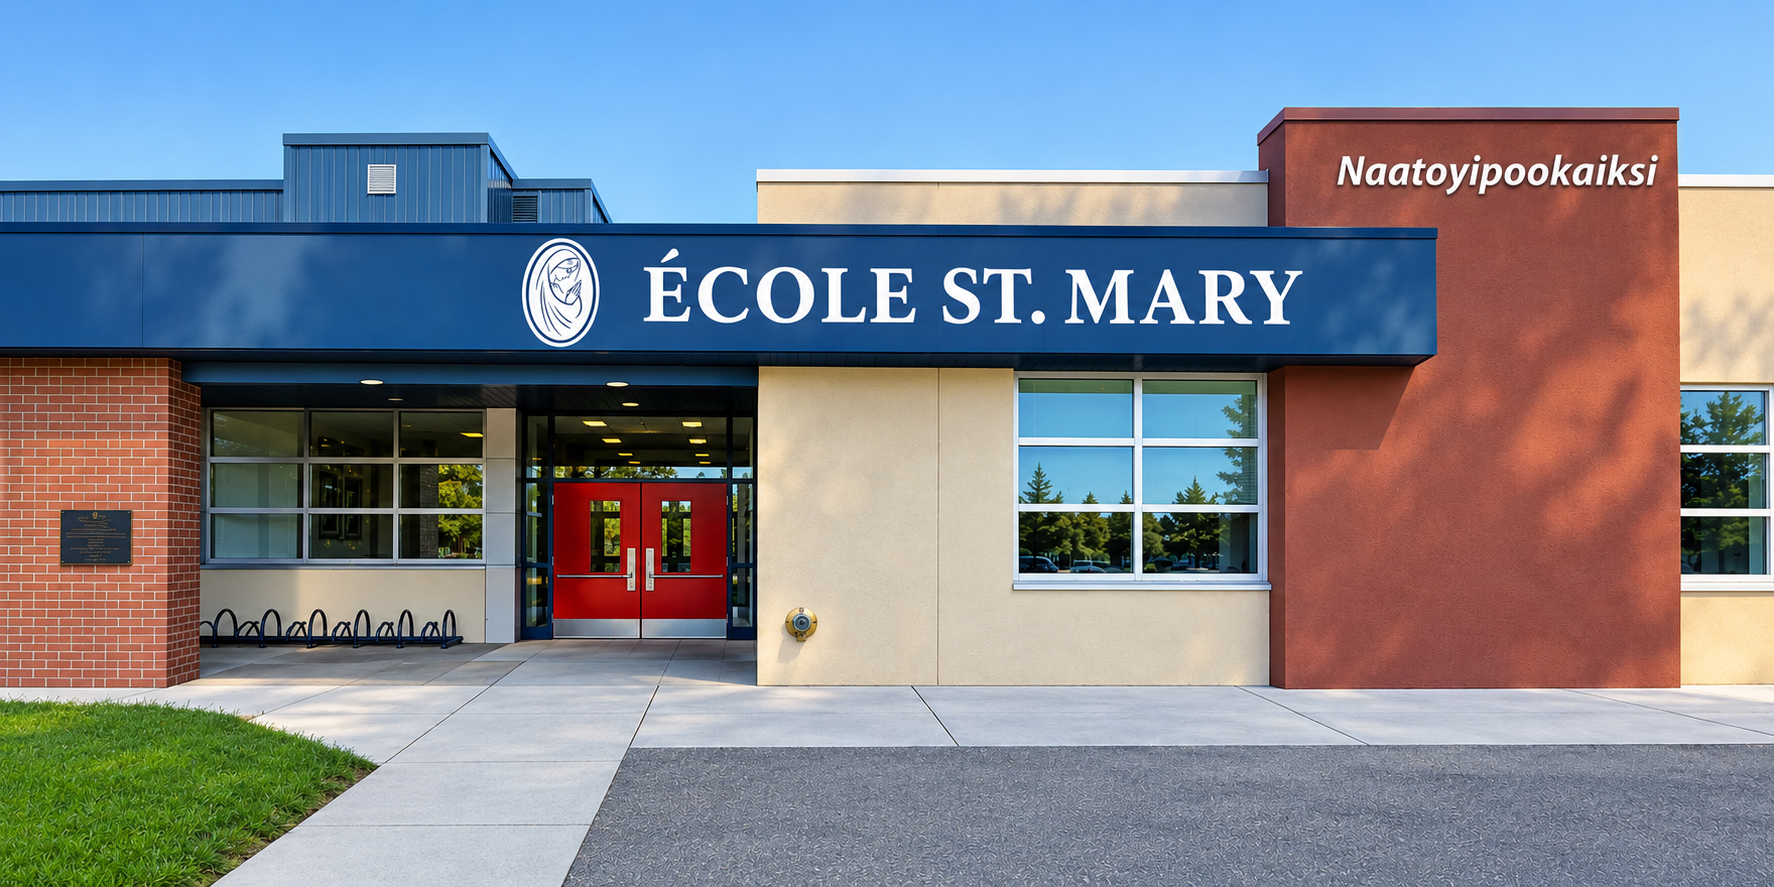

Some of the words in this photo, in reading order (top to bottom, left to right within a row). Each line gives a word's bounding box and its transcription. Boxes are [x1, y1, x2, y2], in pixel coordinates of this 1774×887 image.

[1336, 154, 1659, 196] Naatoyipookaiksi
[643, 248, 917, 325] ÉCOLE
[942, 267, 1046, 326] ST.
[1064, 269, 1304, 326] MARY
